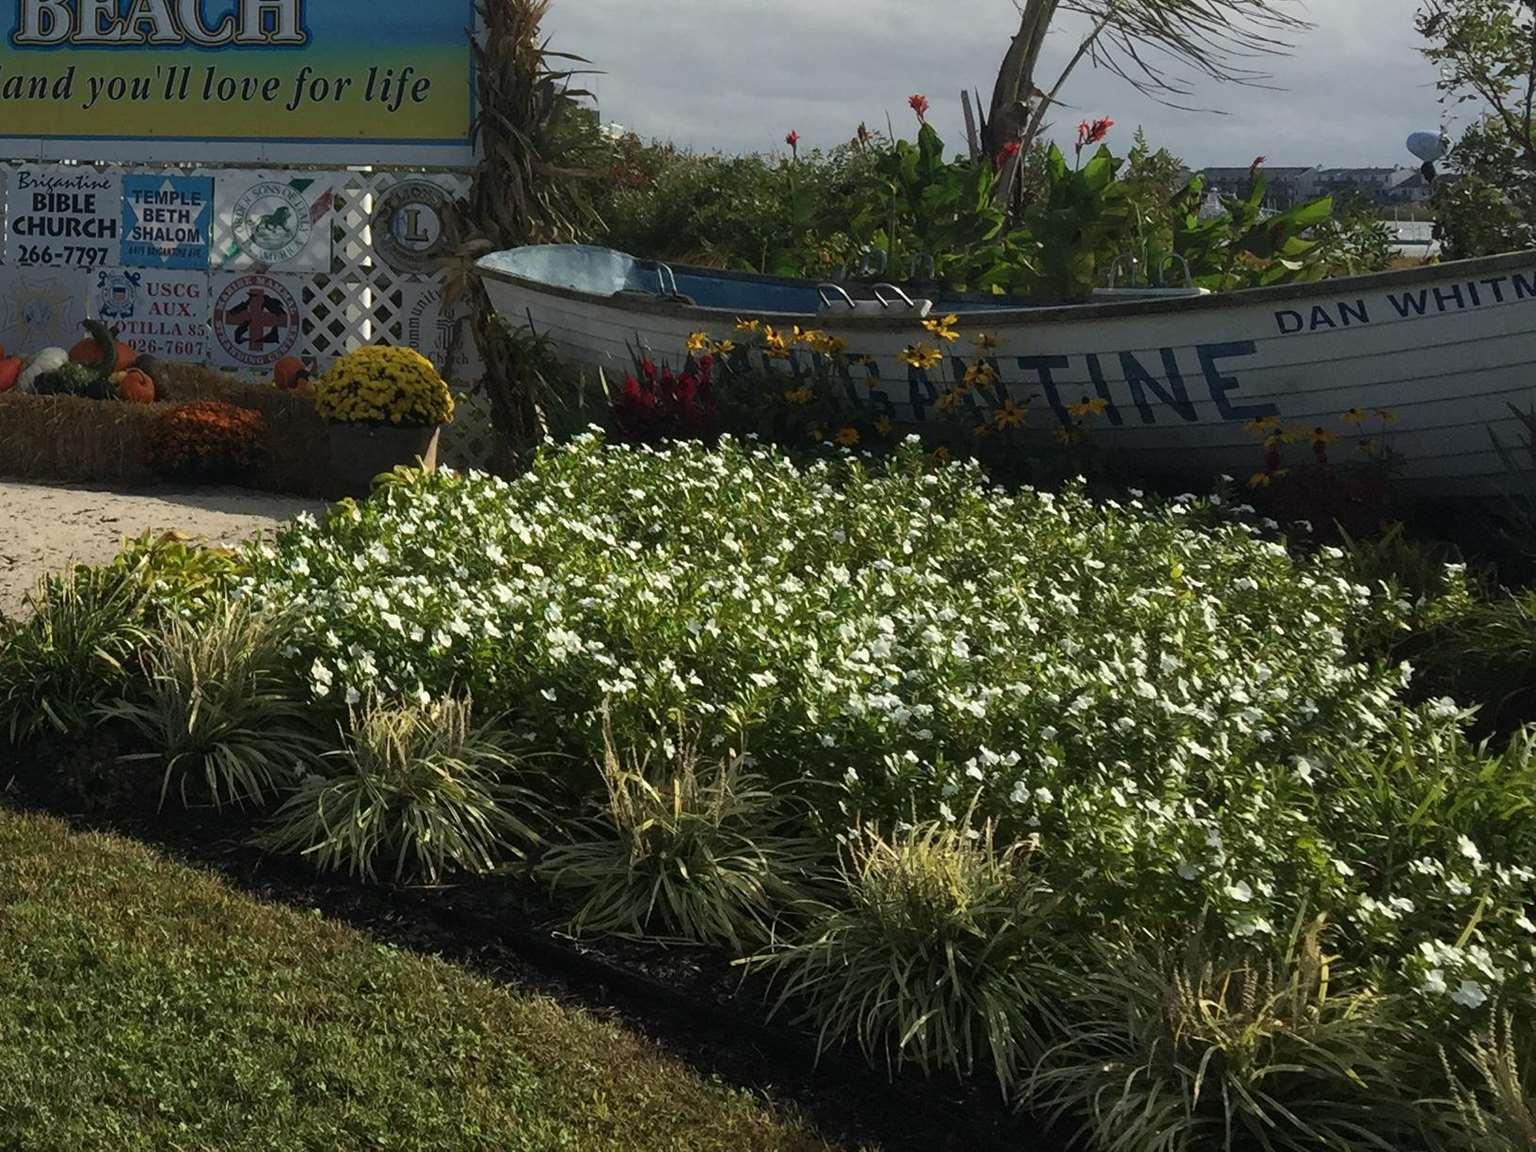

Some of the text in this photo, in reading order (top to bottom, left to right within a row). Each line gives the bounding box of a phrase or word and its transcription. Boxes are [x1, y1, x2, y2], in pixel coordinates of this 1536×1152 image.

[82, 65, 190, 109] you'll
[202, 65, 280, 101] love
[286, 66, 352, 110] for
[364, 66, 431, 111] life
[18, 172, 111, 192] Brigantine
[250, 182, 282, 198] SONS
[33, 193, 96, 213] BIBLE
[132, 190, 201, 206] TEMPLE
[143, 209, 190, 223] BETH
[12, 216, 116, 238] CHURCH
[132, 228, 200, 242] SHALOM
[18, 245, 109, 265] 266-7797
[146, 282, 200, 298] USCG
[149, 302, 196, 317] AUX.
[1275, 300, 1370, 334] DAN
[409, 289, 442, 352] ommunit
[128, 339, 203, 355] 926-7607
